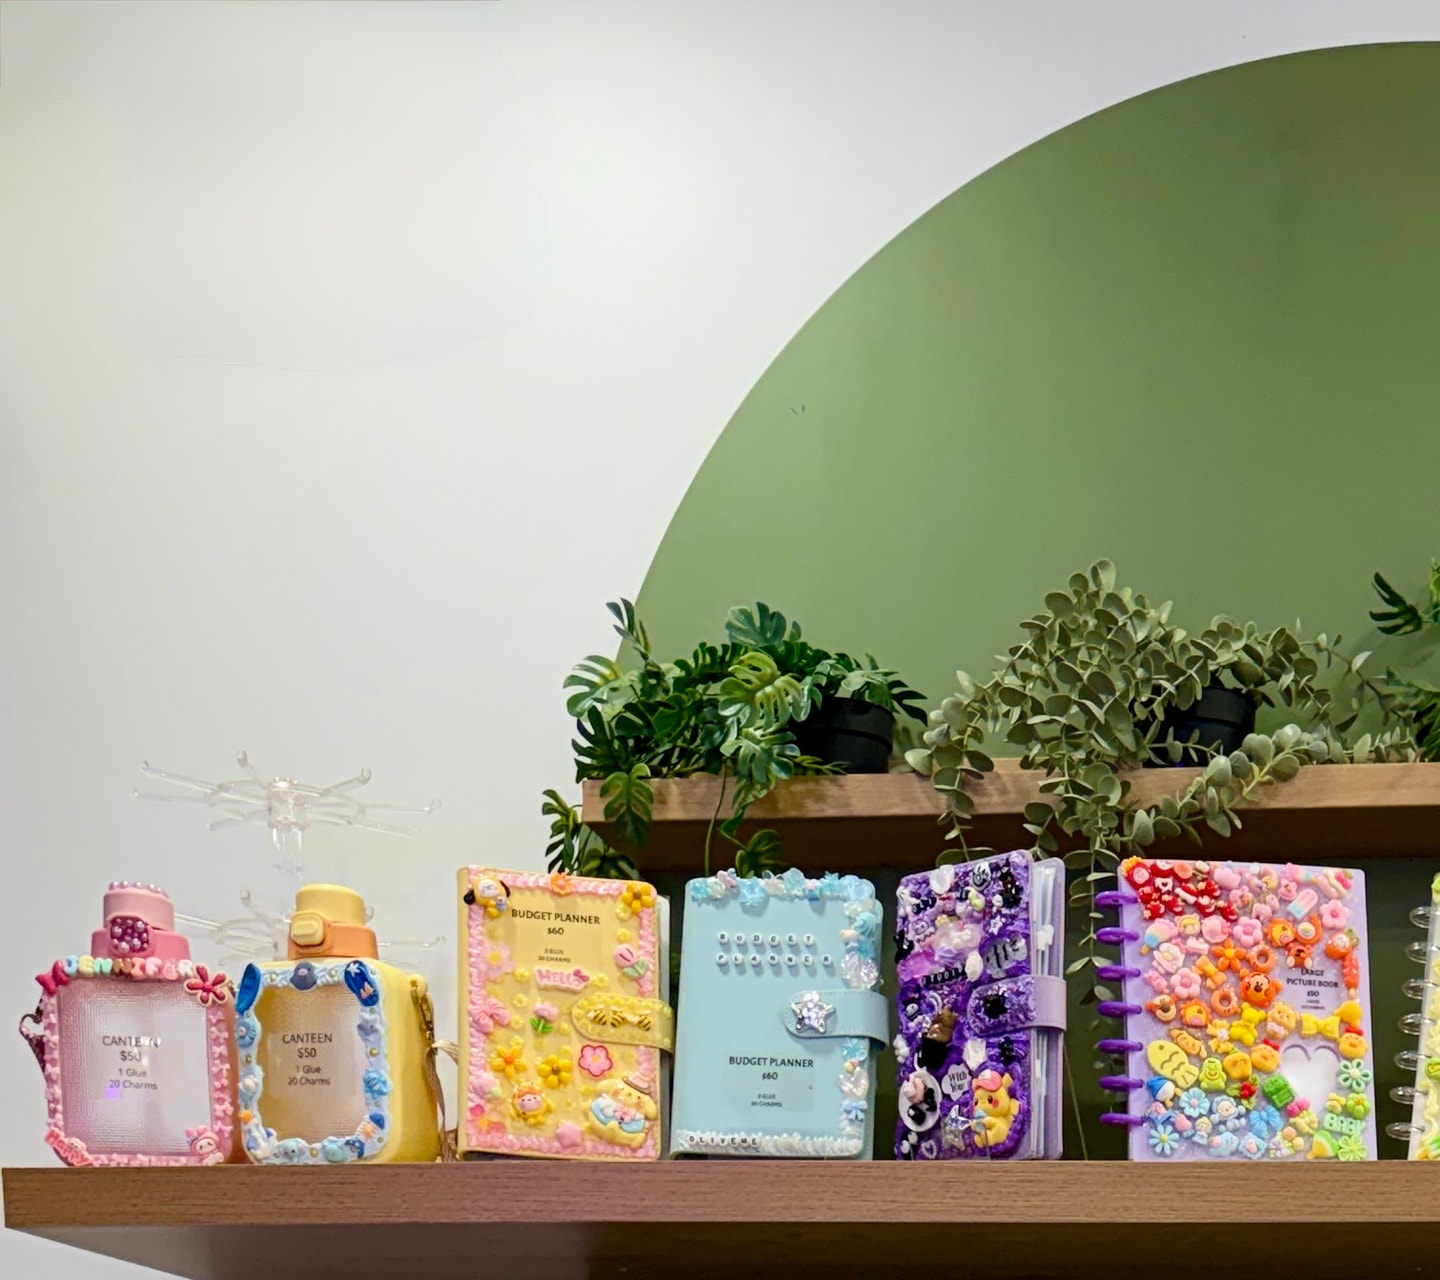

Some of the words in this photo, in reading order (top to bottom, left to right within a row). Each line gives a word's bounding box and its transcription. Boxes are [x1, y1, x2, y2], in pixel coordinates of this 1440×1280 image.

[511, 909, 552, 921] BUDGET
[554, 912, 601, 925] PLANNER
[547, 927, 564, 935] $60
[282, 1033, 333, 1044] CANTEEN
[119, 1050, 143, 1063] $50
[297, 1047, 317, 1059] $50
[729, 1056, 768, 1066] BUDGET
[770, 1057, 814, 1067] PLANNER
[126, 1068, 148, 1077] Glue
[302, 1065, 322, 1074] Glue
[288, 1076, 298, 1086] 20
[299, 1076, 331, 1086] Charms
[762, 1072, 778, 1080] $60
[109, 1080, 120, 1089] 20
[122, 1079, 158, 1090] Charms
